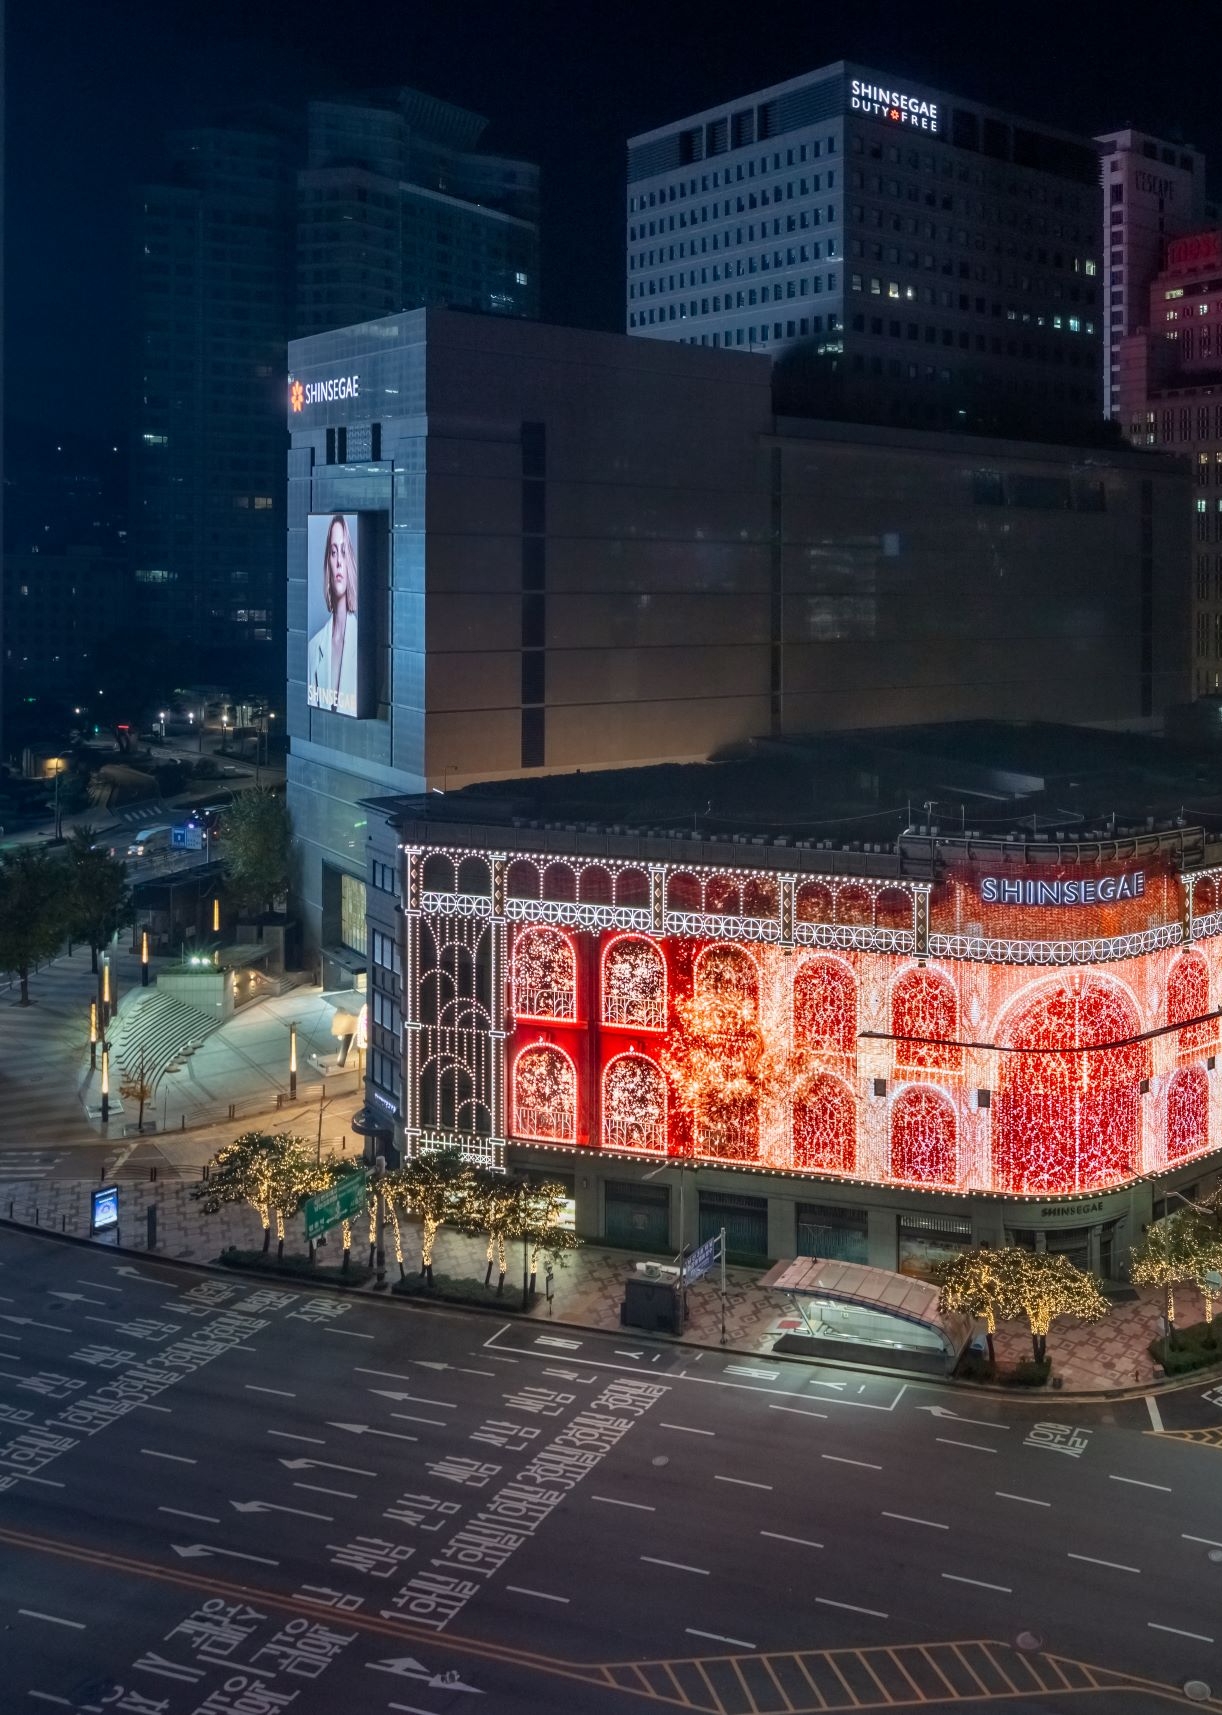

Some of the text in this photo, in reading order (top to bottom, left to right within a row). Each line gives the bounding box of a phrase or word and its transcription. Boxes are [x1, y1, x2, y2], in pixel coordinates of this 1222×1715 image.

[852, 80, 937, 119] SHINSEGAE
[852, 97, 937, 132] DUTY FREE
[305, 375, 359, 404] SHINSEGAE
[308, 685, 357, 710] SHINSEGAE
[982, 871, 1145, 905] SHINSEGAE
[1041, 1202, 1103, 1217] SHINSEGAE
[1022, 1421, 1094, 1458] 서울역
[164, 1598, 267, 1656] 숭례문
[249, 1618, 360, 1678] 광화문
[192, 1676, 301, 1715] 광화
